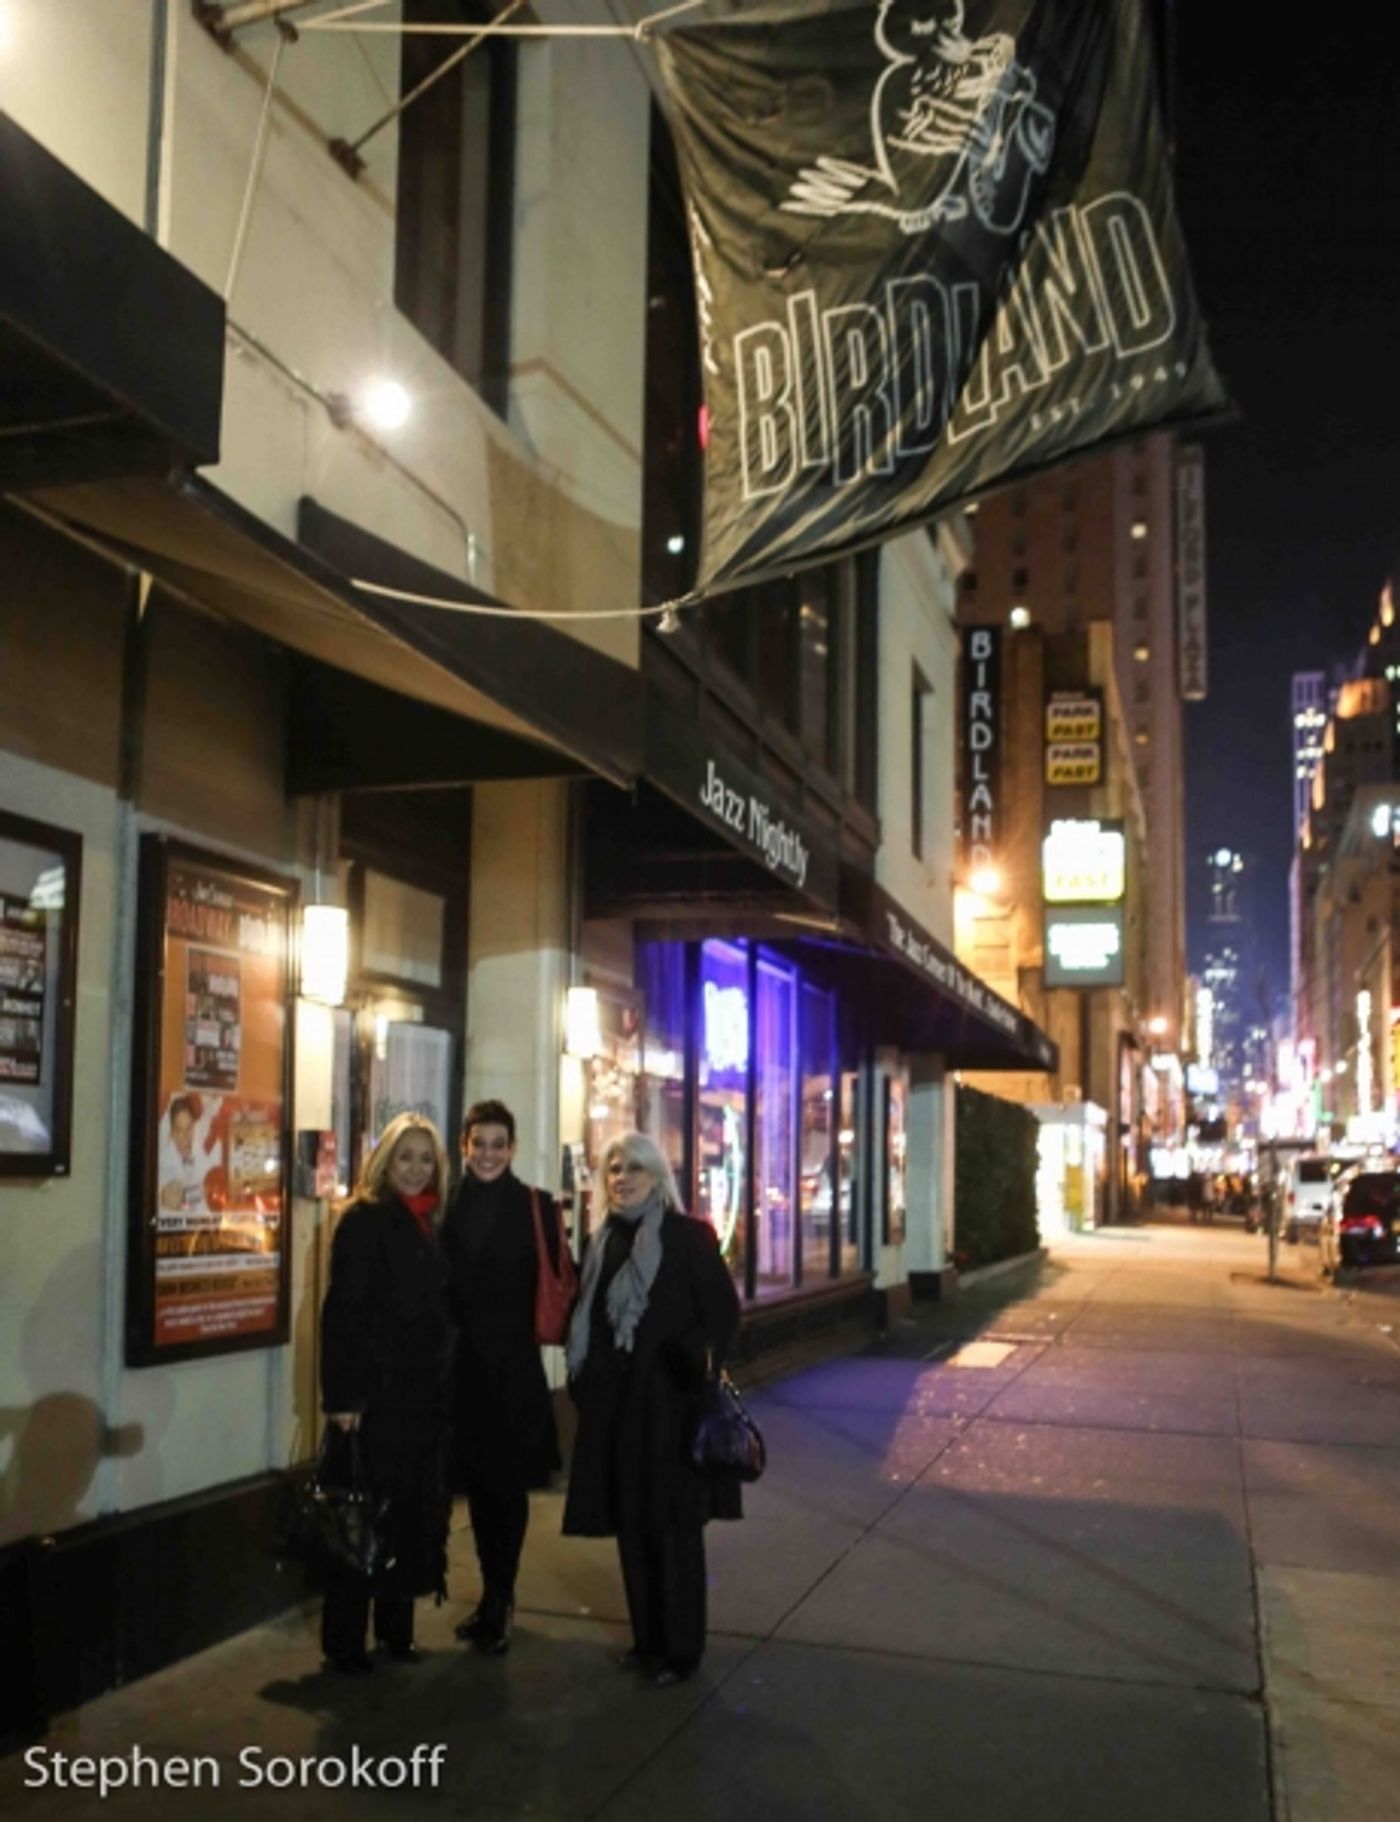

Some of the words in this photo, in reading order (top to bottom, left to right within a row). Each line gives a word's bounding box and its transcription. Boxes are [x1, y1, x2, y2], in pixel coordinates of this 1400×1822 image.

[734, 191, 1175, 500] BIRDLAND
[1051, 706, 1095, 719] PARK
[1051, 723, 1096, 738] FAST
[1051, 747, 1095, 760] PARK
[1051, 764, 1096, 779] FAST
[701, 759, 746, 832] Jazz
[748, 796, 810, 888] Nightly
